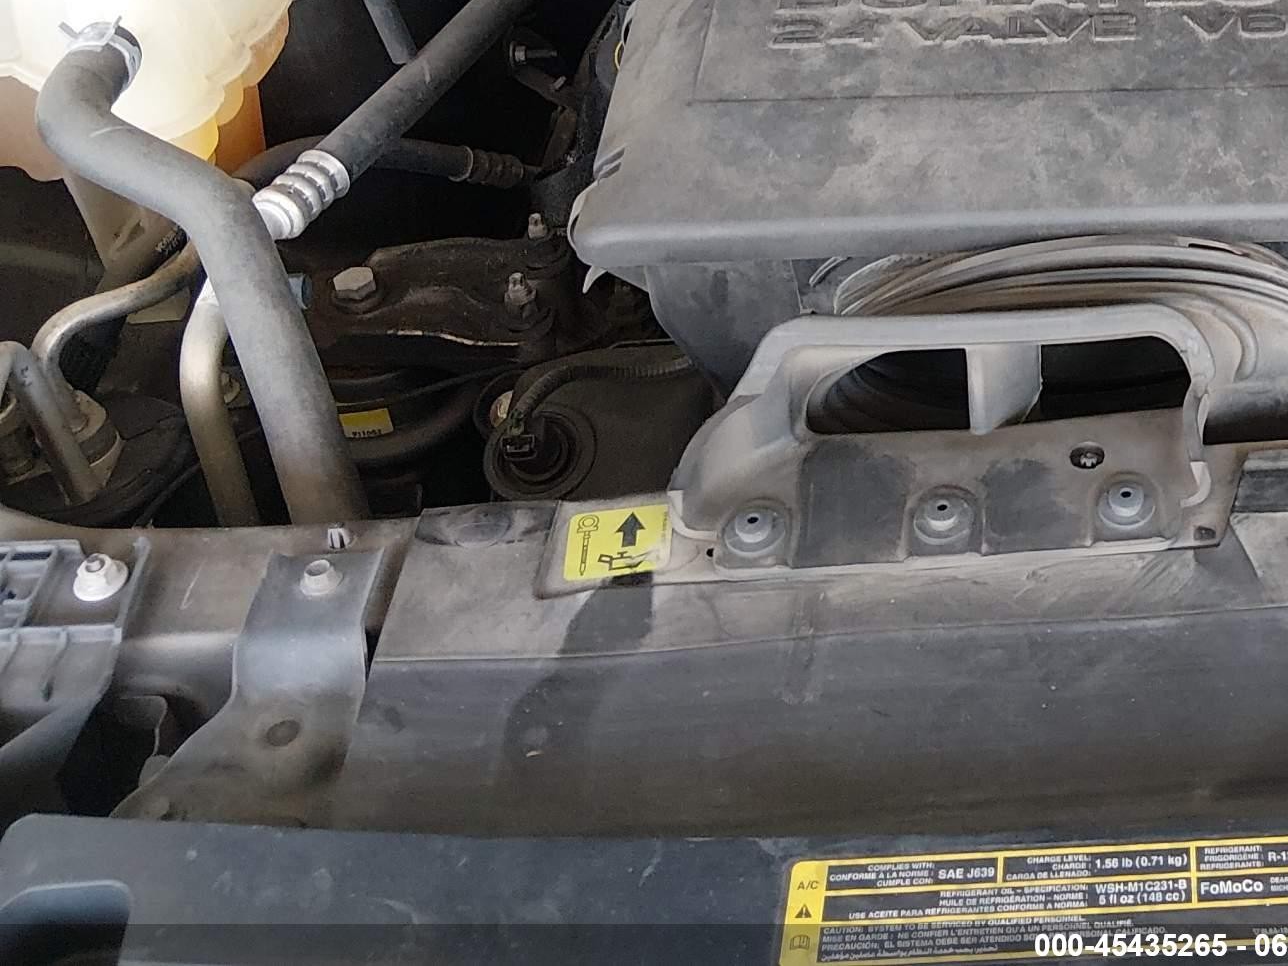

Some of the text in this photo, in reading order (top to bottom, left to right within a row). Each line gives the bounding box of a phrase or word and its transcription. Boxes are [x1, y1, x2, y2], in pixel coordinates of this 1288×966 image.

[769, 16, 881, 49] 24
[901, 12, 1138, 47] VALVE
[1027, 856, 1061, 865] CHARGE
[1052, 863, 1087, 871] CHARGE
[1122, 857, 1133, 868] lb
[1136, 856, 1164, 868] (0.71
[1168, 854, 1188, 866] kg)
[867, 863, 910, 872] COMPLIES
[938, 867, 995, 880] SAE J639
[829, 872, 877, 882] CONFORME
[876, 879, 910, 887] CUMPLE
[1006, 872, 1035, 881] CARGA
[797, 880, 820, 890] A/C
[1095, 879, 1187, 894] WSH-M1C231-B
[1200, 878, 1264, 895] FoMoCo
[940, 888, 998, 898] REFRIGERANT
[1109, 894, 1118, 904] fl
[1120, 895, 1134, 903] oz
[1137, 892, 1162, 904] (148
[1165, 890, 1186, 902] cc)
[939, 899, 963, 907] HUILE
[965, 898, 977, 906] DE
[849, 911, 865, 920] USE
[868, 909, 899, 918] ACEITE
[900, 908, 924, 916] PARA
[924, 905, 995, 915] REFRIGERANTES
[996, 903, 1044, 912] CONFORME
[868, 924, 902, 932] SYSTEM
[917, 922, 928, 930] BE
[931, 920, 972, 929] SERVICED
[987, 917, 1032, 926] QUALIFIED
[822, 934, 843, 943] MISE
[911, 930, 948, 939] CONFIER
[1042, 921, 1091, 931] PERSONNEL
[884, 940, 895, 948] EL
[897, 939, 933, 948] SISTEMA
[935, 937, 958, 945] DEBE
[960, 936, 977, 945] SER
[980, 935, 1021, 944] ATENDIDO
